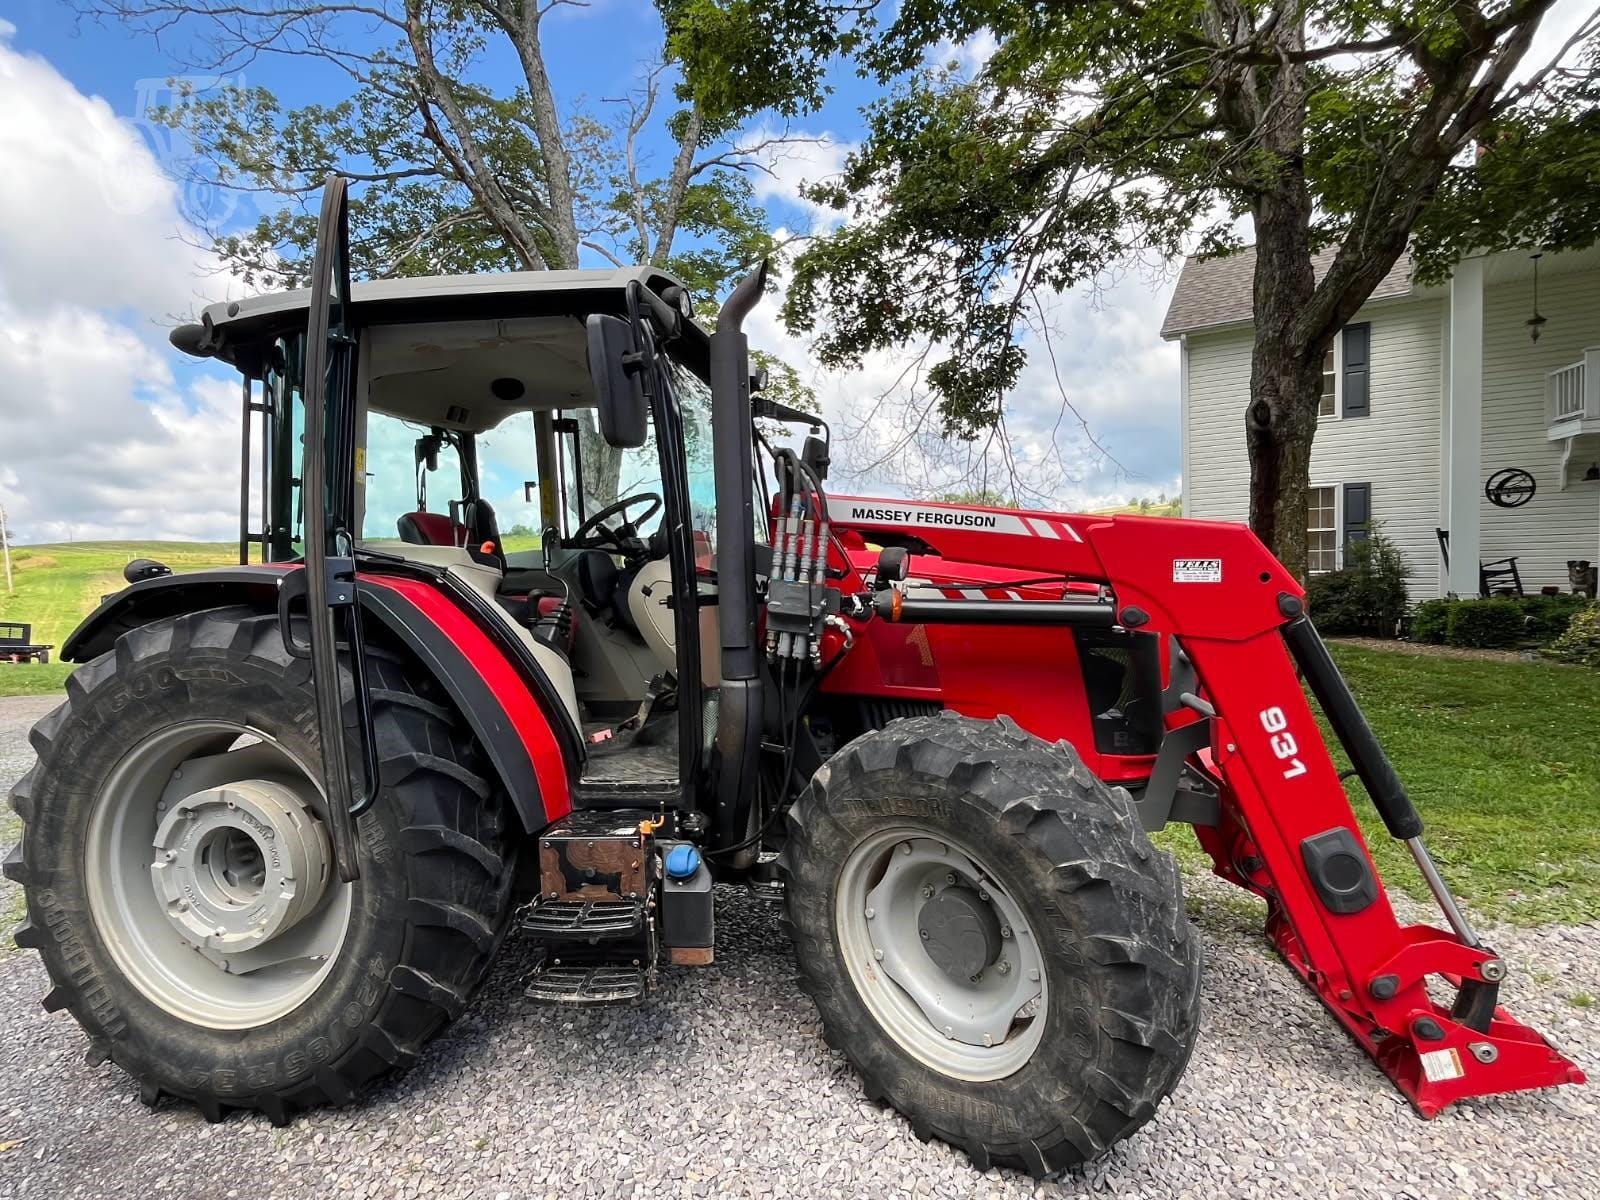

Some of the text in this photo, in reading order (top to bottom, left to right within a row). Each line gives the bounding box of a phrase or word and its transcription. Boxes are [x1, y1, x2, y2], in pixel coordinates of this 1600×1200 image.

[852, 507, 996, 528] MASSEY FERGUSON
[1259, 706, 1308, 779] 931
